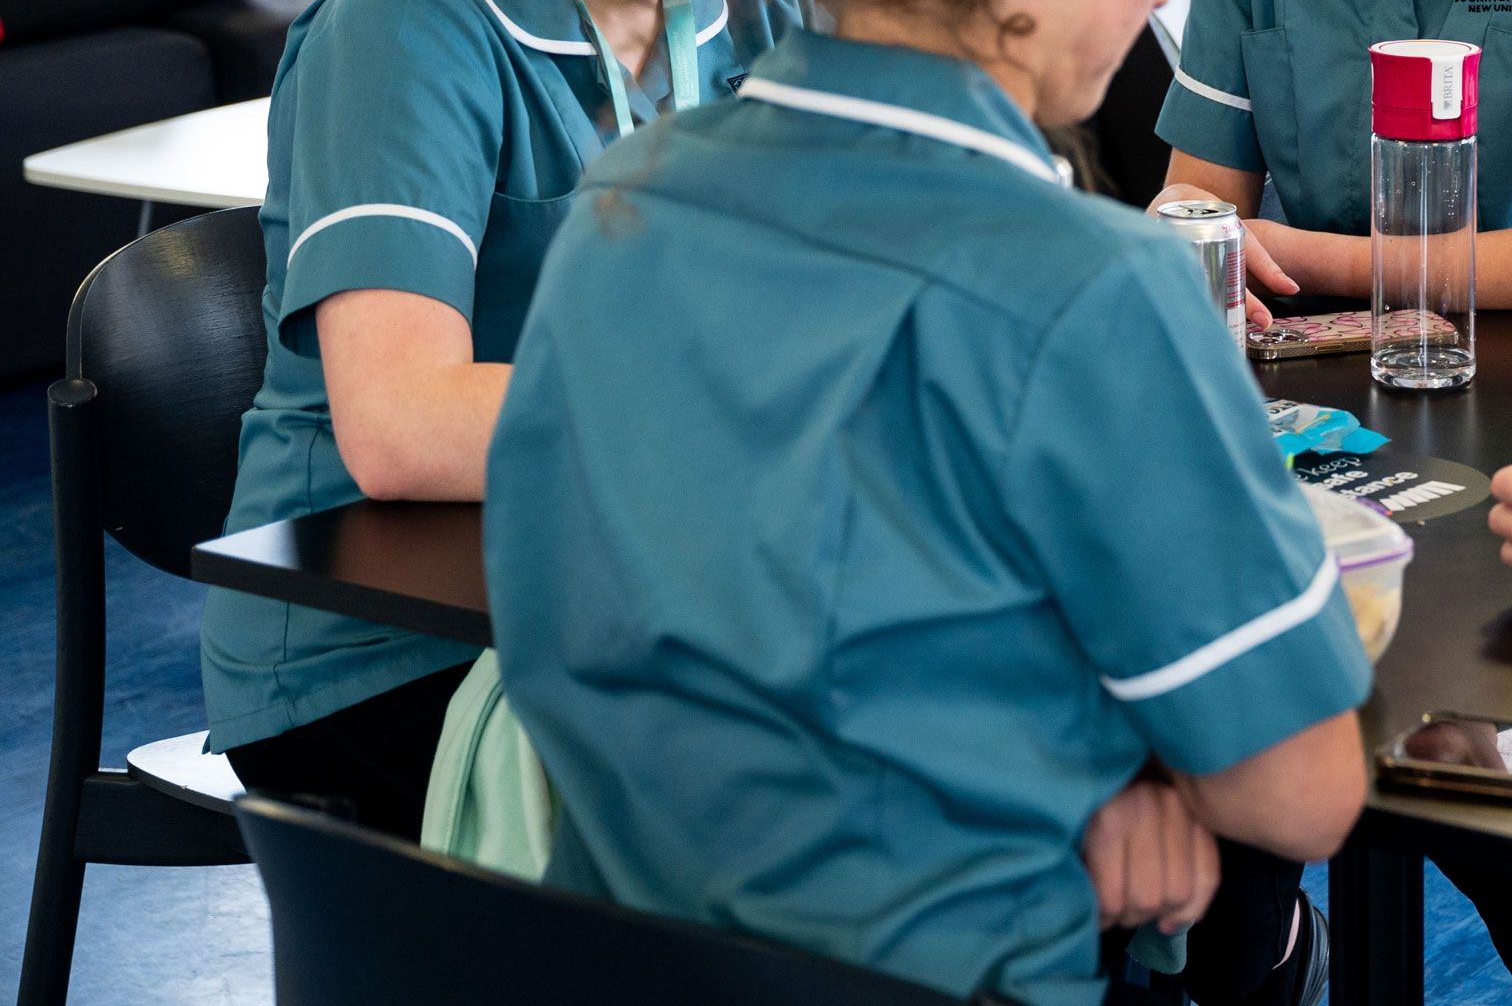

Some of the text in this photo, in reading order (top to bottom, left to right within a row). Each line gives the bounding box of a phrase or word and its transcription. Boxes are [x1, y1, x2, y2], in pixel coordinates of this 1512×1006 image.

[1468, 3, 1492, 13] NEW
[1443, 66, 1454, 100] BRITA
[1297, 456, 1362, 477] keep
